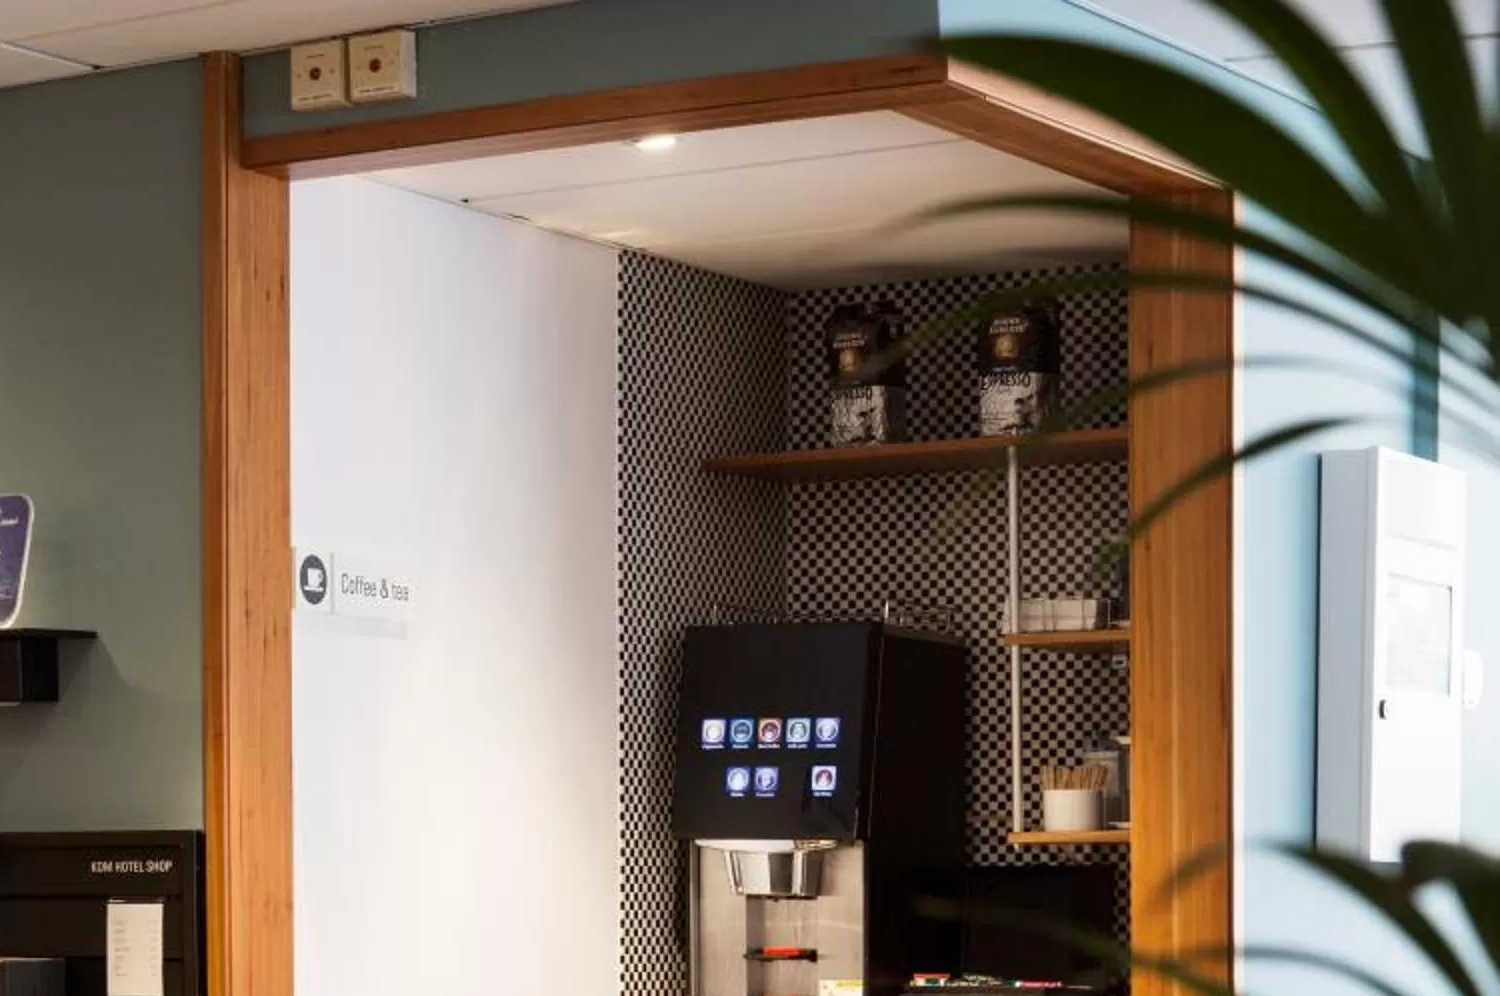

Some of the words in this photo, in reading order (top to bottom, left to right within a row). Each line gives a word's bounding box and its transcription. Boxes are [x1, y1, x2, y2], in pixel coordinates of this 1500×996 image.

[341, 572, 377, 597] Coffee
[379, 577, 389, 599] &
[391, 583, 409, 601] tea
[115, 860, 145, 873] HOTEL
